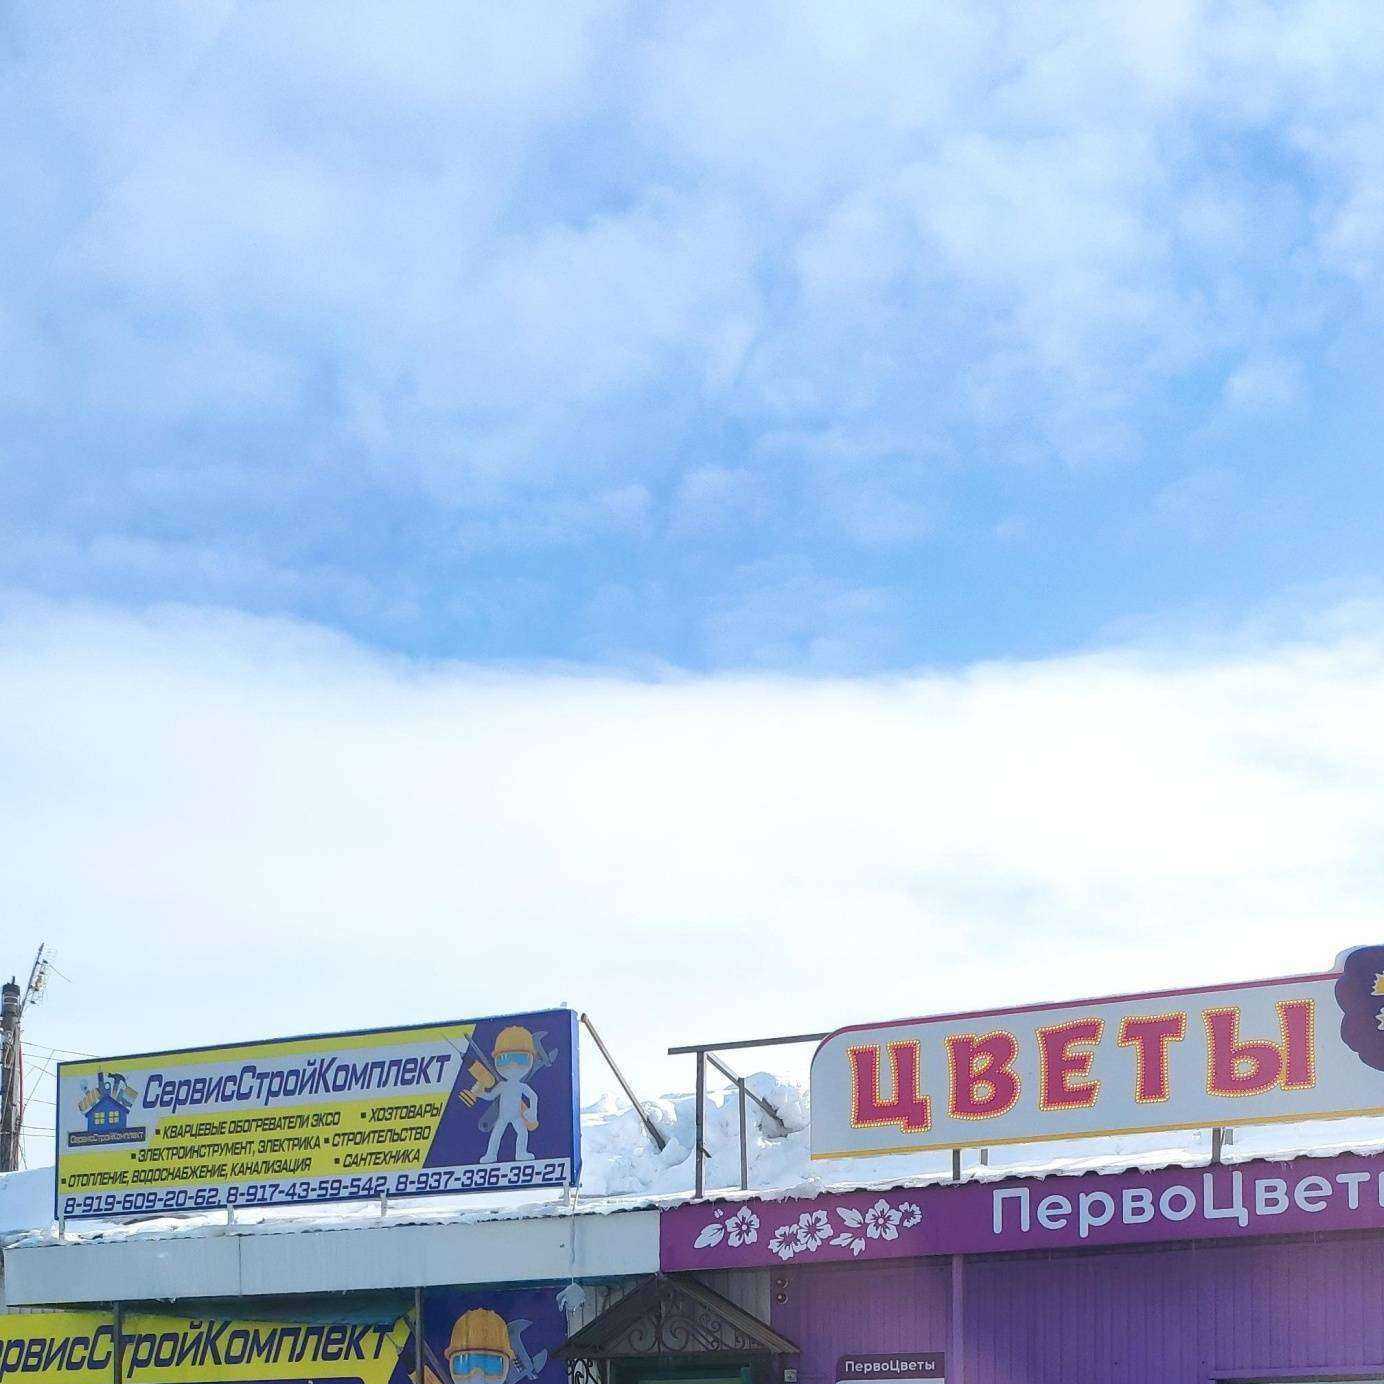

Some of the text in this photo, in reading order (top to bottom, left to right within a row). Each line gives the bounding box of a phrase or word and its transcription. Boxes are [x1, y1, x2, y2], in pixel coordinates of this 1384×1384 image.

[847, 999, 1316, 1134] ЦВЕТЫ
[142, 1054, 453, 1113] СервисСтройКомплект
[162, 1110, 341, 1140] КВАРЦЕВЫЕ ОБОГРЕВАТЕЛИ ЭКСО
[368, 1102, 443, 1122] ХОЗТОВАРЫ
[138, 1135, 321, 1163] ЭЛЕКТРОИНСТРУМЕНТ, ЭЛЕКТРИКА
[332, 1125, 431, 1148] СТРОИТЕЛЬСТВО
[67, 1157, 312, 1188] ОТОПЛЕНИЕ, ВОДОСНАБЖЕНИЕ, КАНАЛИЗАЦИЯ
[342, 1149, 420, 1169] САНТЕХНИКА
[63, 1162, 568, 1215] 8-919-609-20-62, 8-917-43-59-542, 8-937-336-39-21
[992, 1170, 1384, 1239] ПервоЦвет
[0, 1320, 394, 1383] рвисСтройКомплект
[845, 1359, 936, 1375] ПервоЦветы
